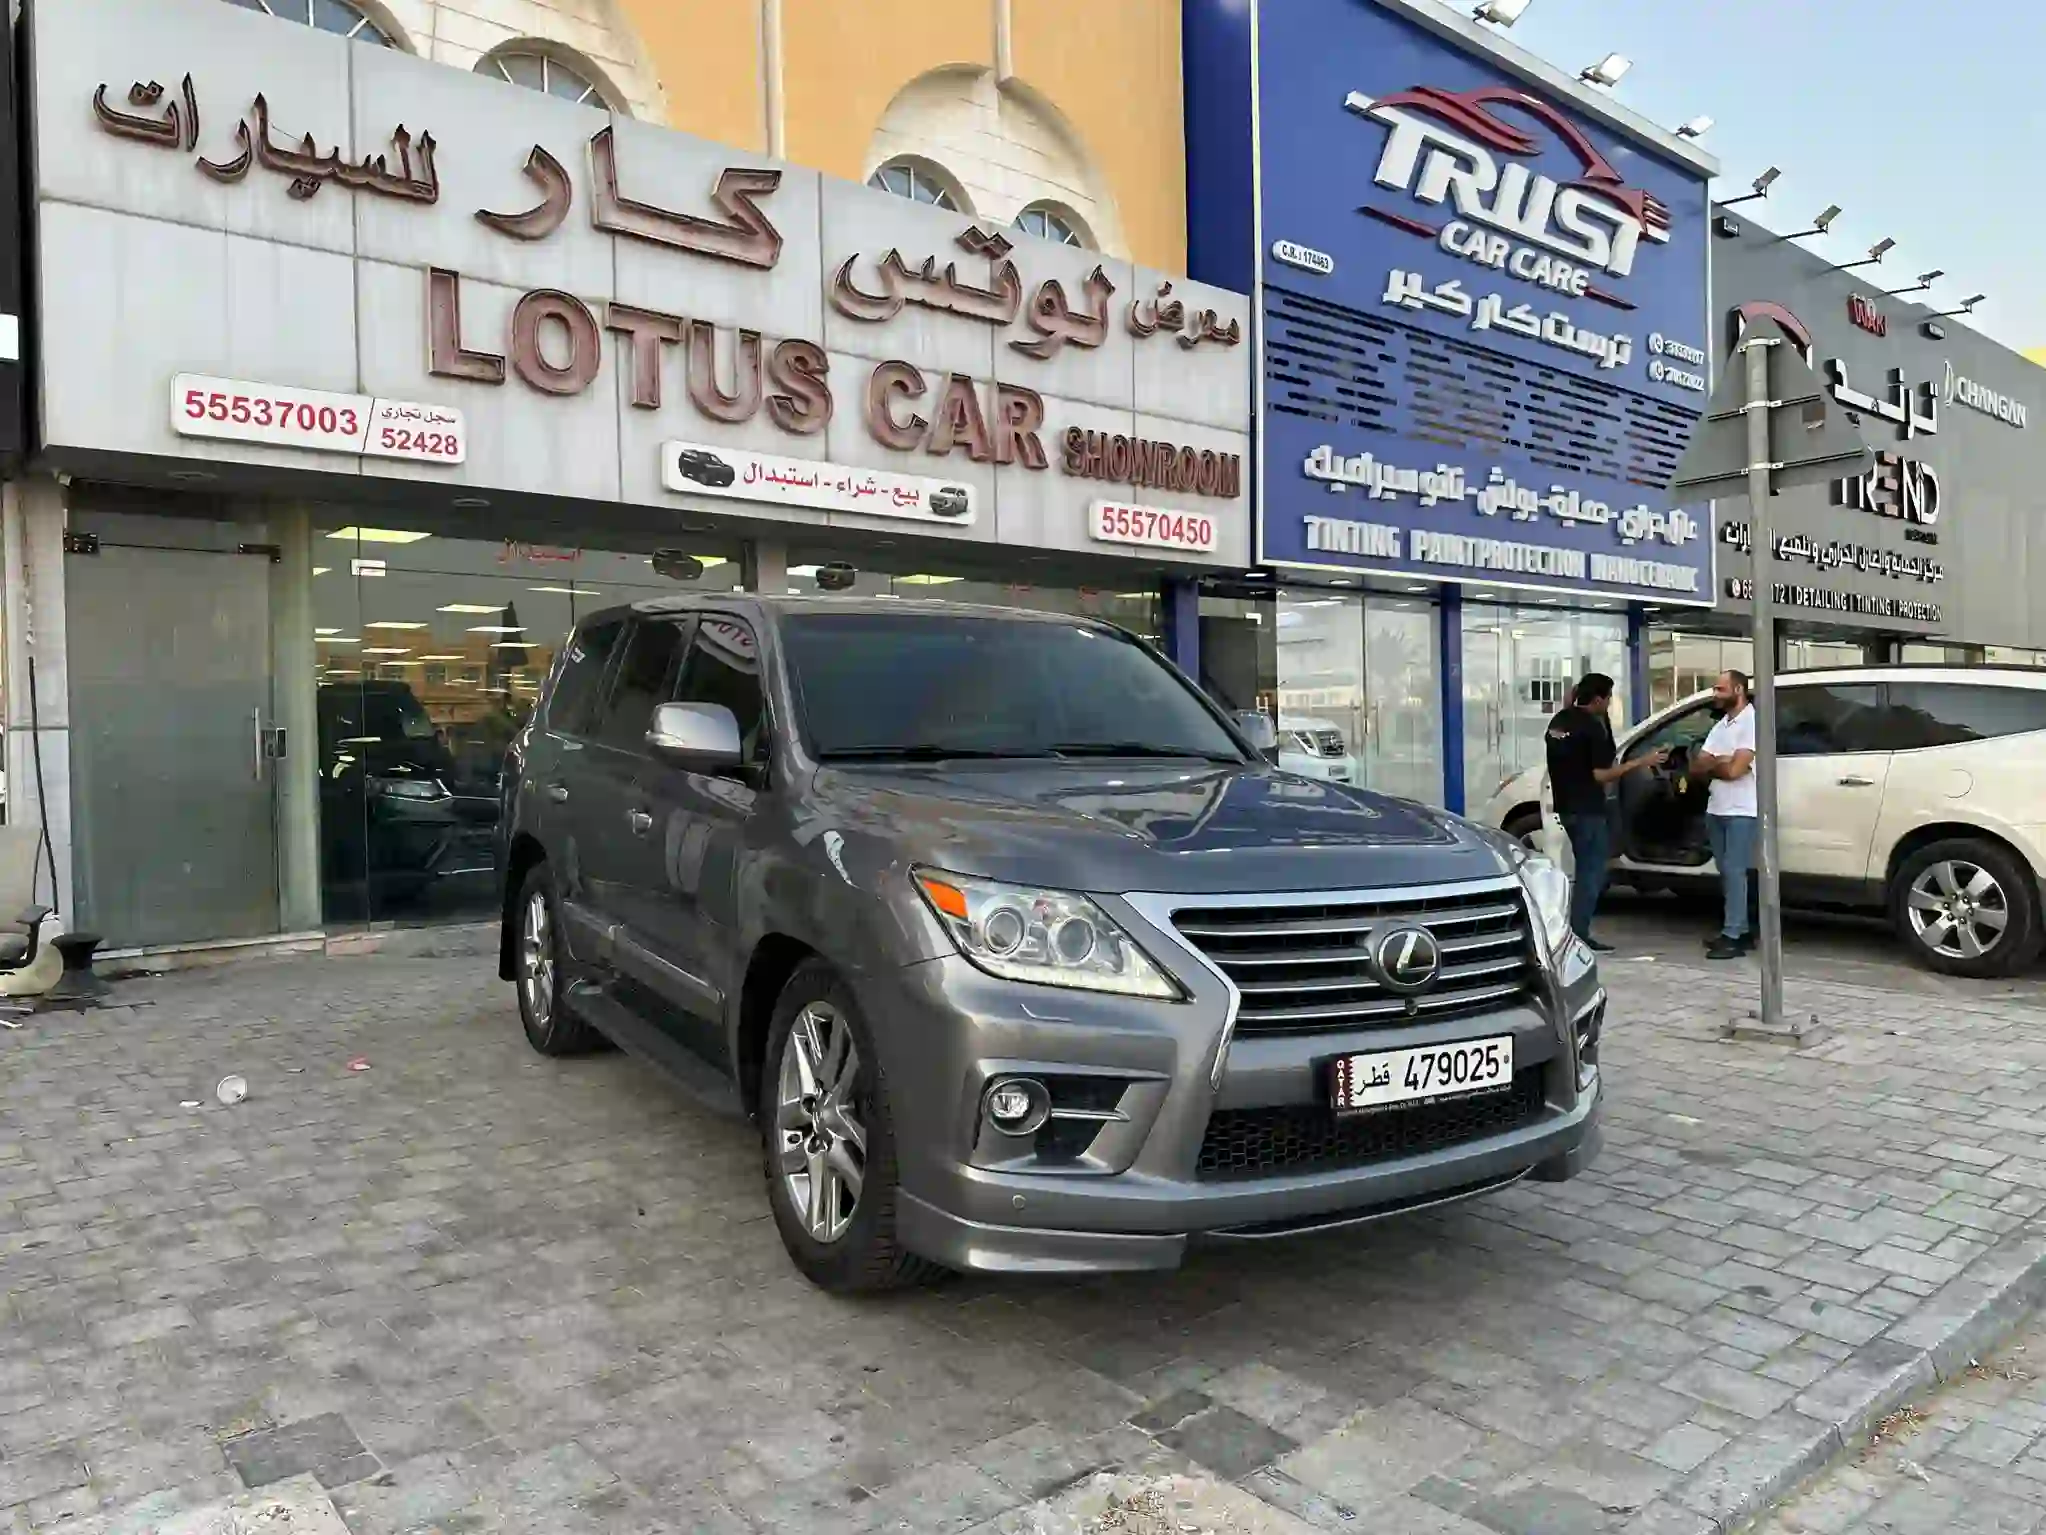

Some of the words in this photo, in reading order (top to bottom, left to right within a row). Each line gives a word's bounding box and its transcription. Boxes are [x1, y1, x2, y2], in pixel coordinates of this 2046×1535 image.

[92, 71, 440, 204] للسيارات
[475, 125, 783, 270] كار
[1344, 90, 1672, 278] TRUST
[1439, 220, 1511, 269] CAR
[1508, 246, 1590, 297] CARE
[1127, 280, 1241, 351] معرض
[427, 265, 833, 434] LOTUS
[867, 359, 1049, 470] CAR
[1062, 425, 1241, 499] SHOWROOM
[1957, 376, 2026, 429] CHANGAN
[185, 389, 358, 436] 55537003
[381, 406, 422, 423] تجاري
[424, 411, 456, 425] سجل
[381, 427, 459, 456] 52428
[743, 461, 819, 493] استبدال
[836, 475, 877, 499] شراء
[891, 484, 921, 507] بيع
[1101, 506, 1212, 545] 55570450
[1304, 514, 1401, 558] TINTING
[1795, 584, 1848, 611] DETAILING
[1856, 593, 1892, 616] TINTING
[1899, 600, 1943, 623] PROTECTION
[1336, 1059, 1345, 1109] QATAR
[1354, 1062, 1392, 1096] قطر
[1403, 1044, 1500, 1091] 479025
